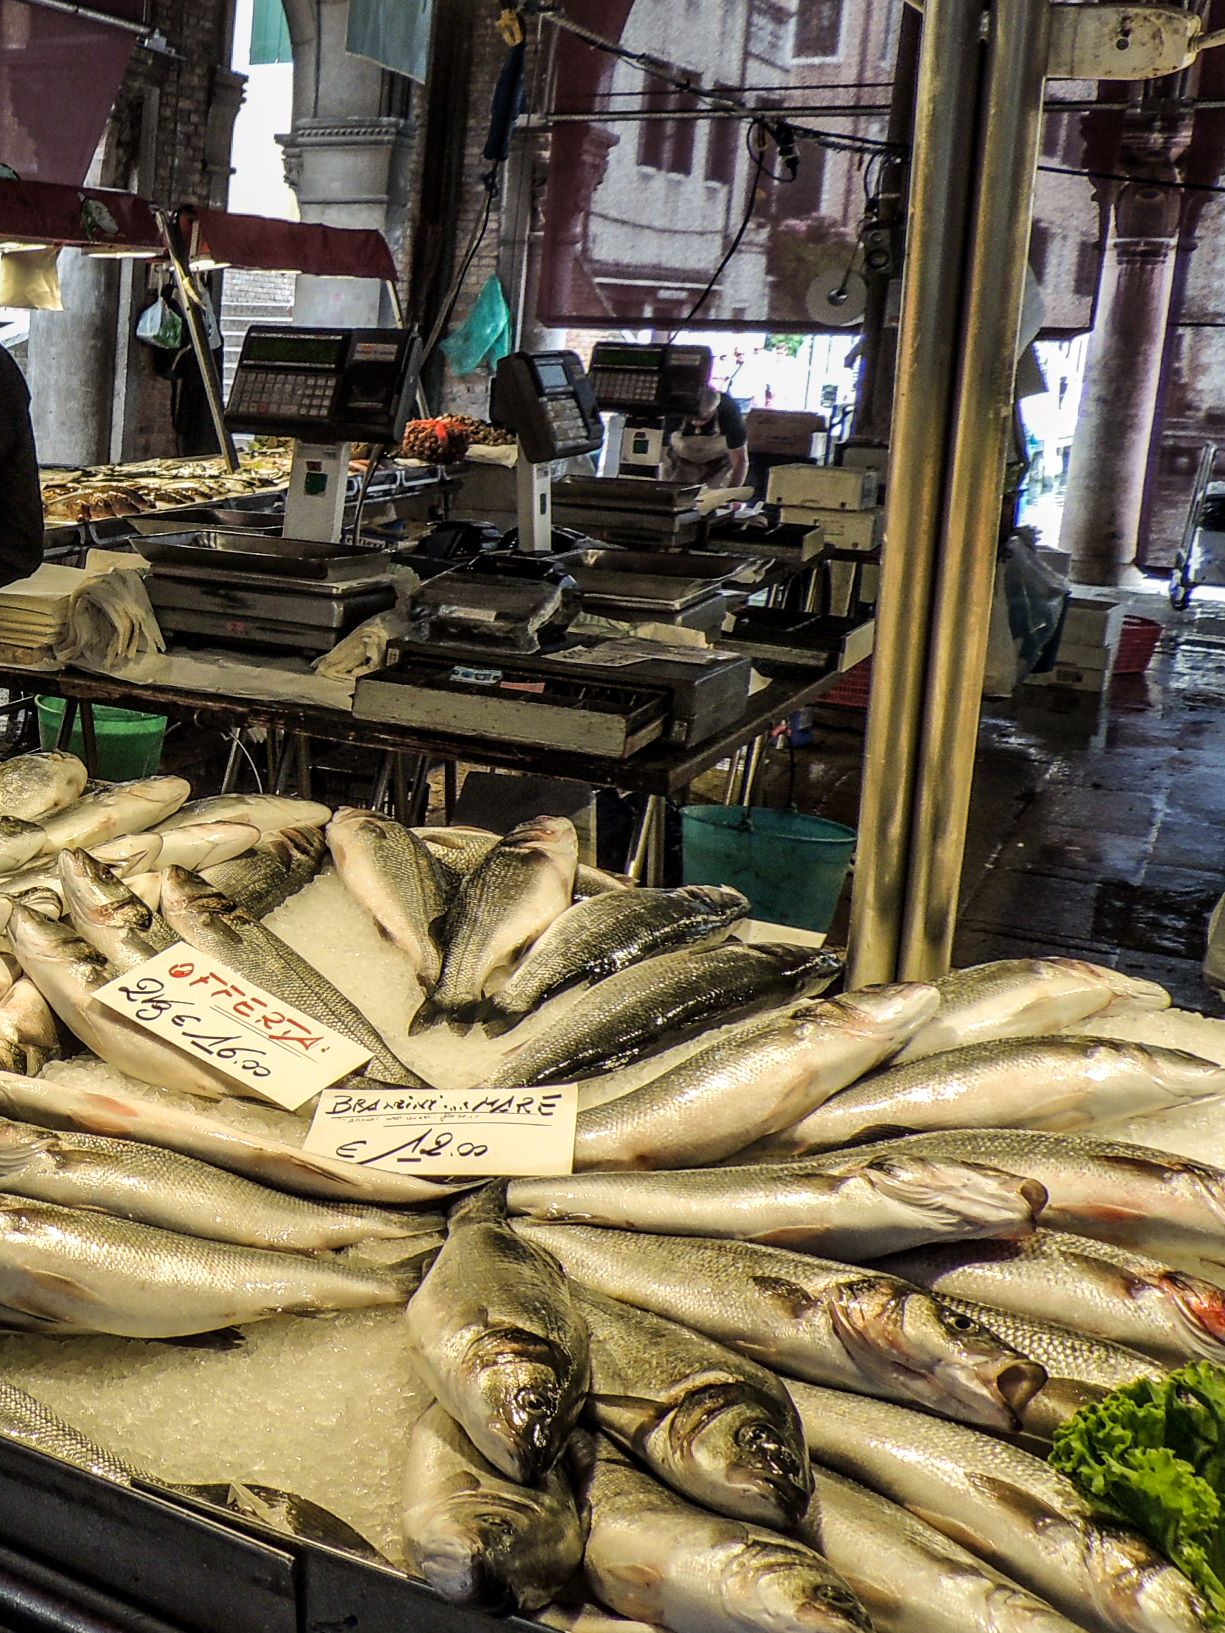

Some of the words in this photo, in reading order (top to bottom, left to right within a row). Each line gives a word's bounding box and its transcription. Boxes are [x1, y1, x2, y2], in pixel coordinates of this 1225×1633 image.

[171, 1014, 202, 1027] €
[181, 1031, 272, 1078] 16.00
[471, 1094, 564, 1117] MARE
[335, 1140, 367, 1159] €
[358, 1128, 489, 1167] 12.00
